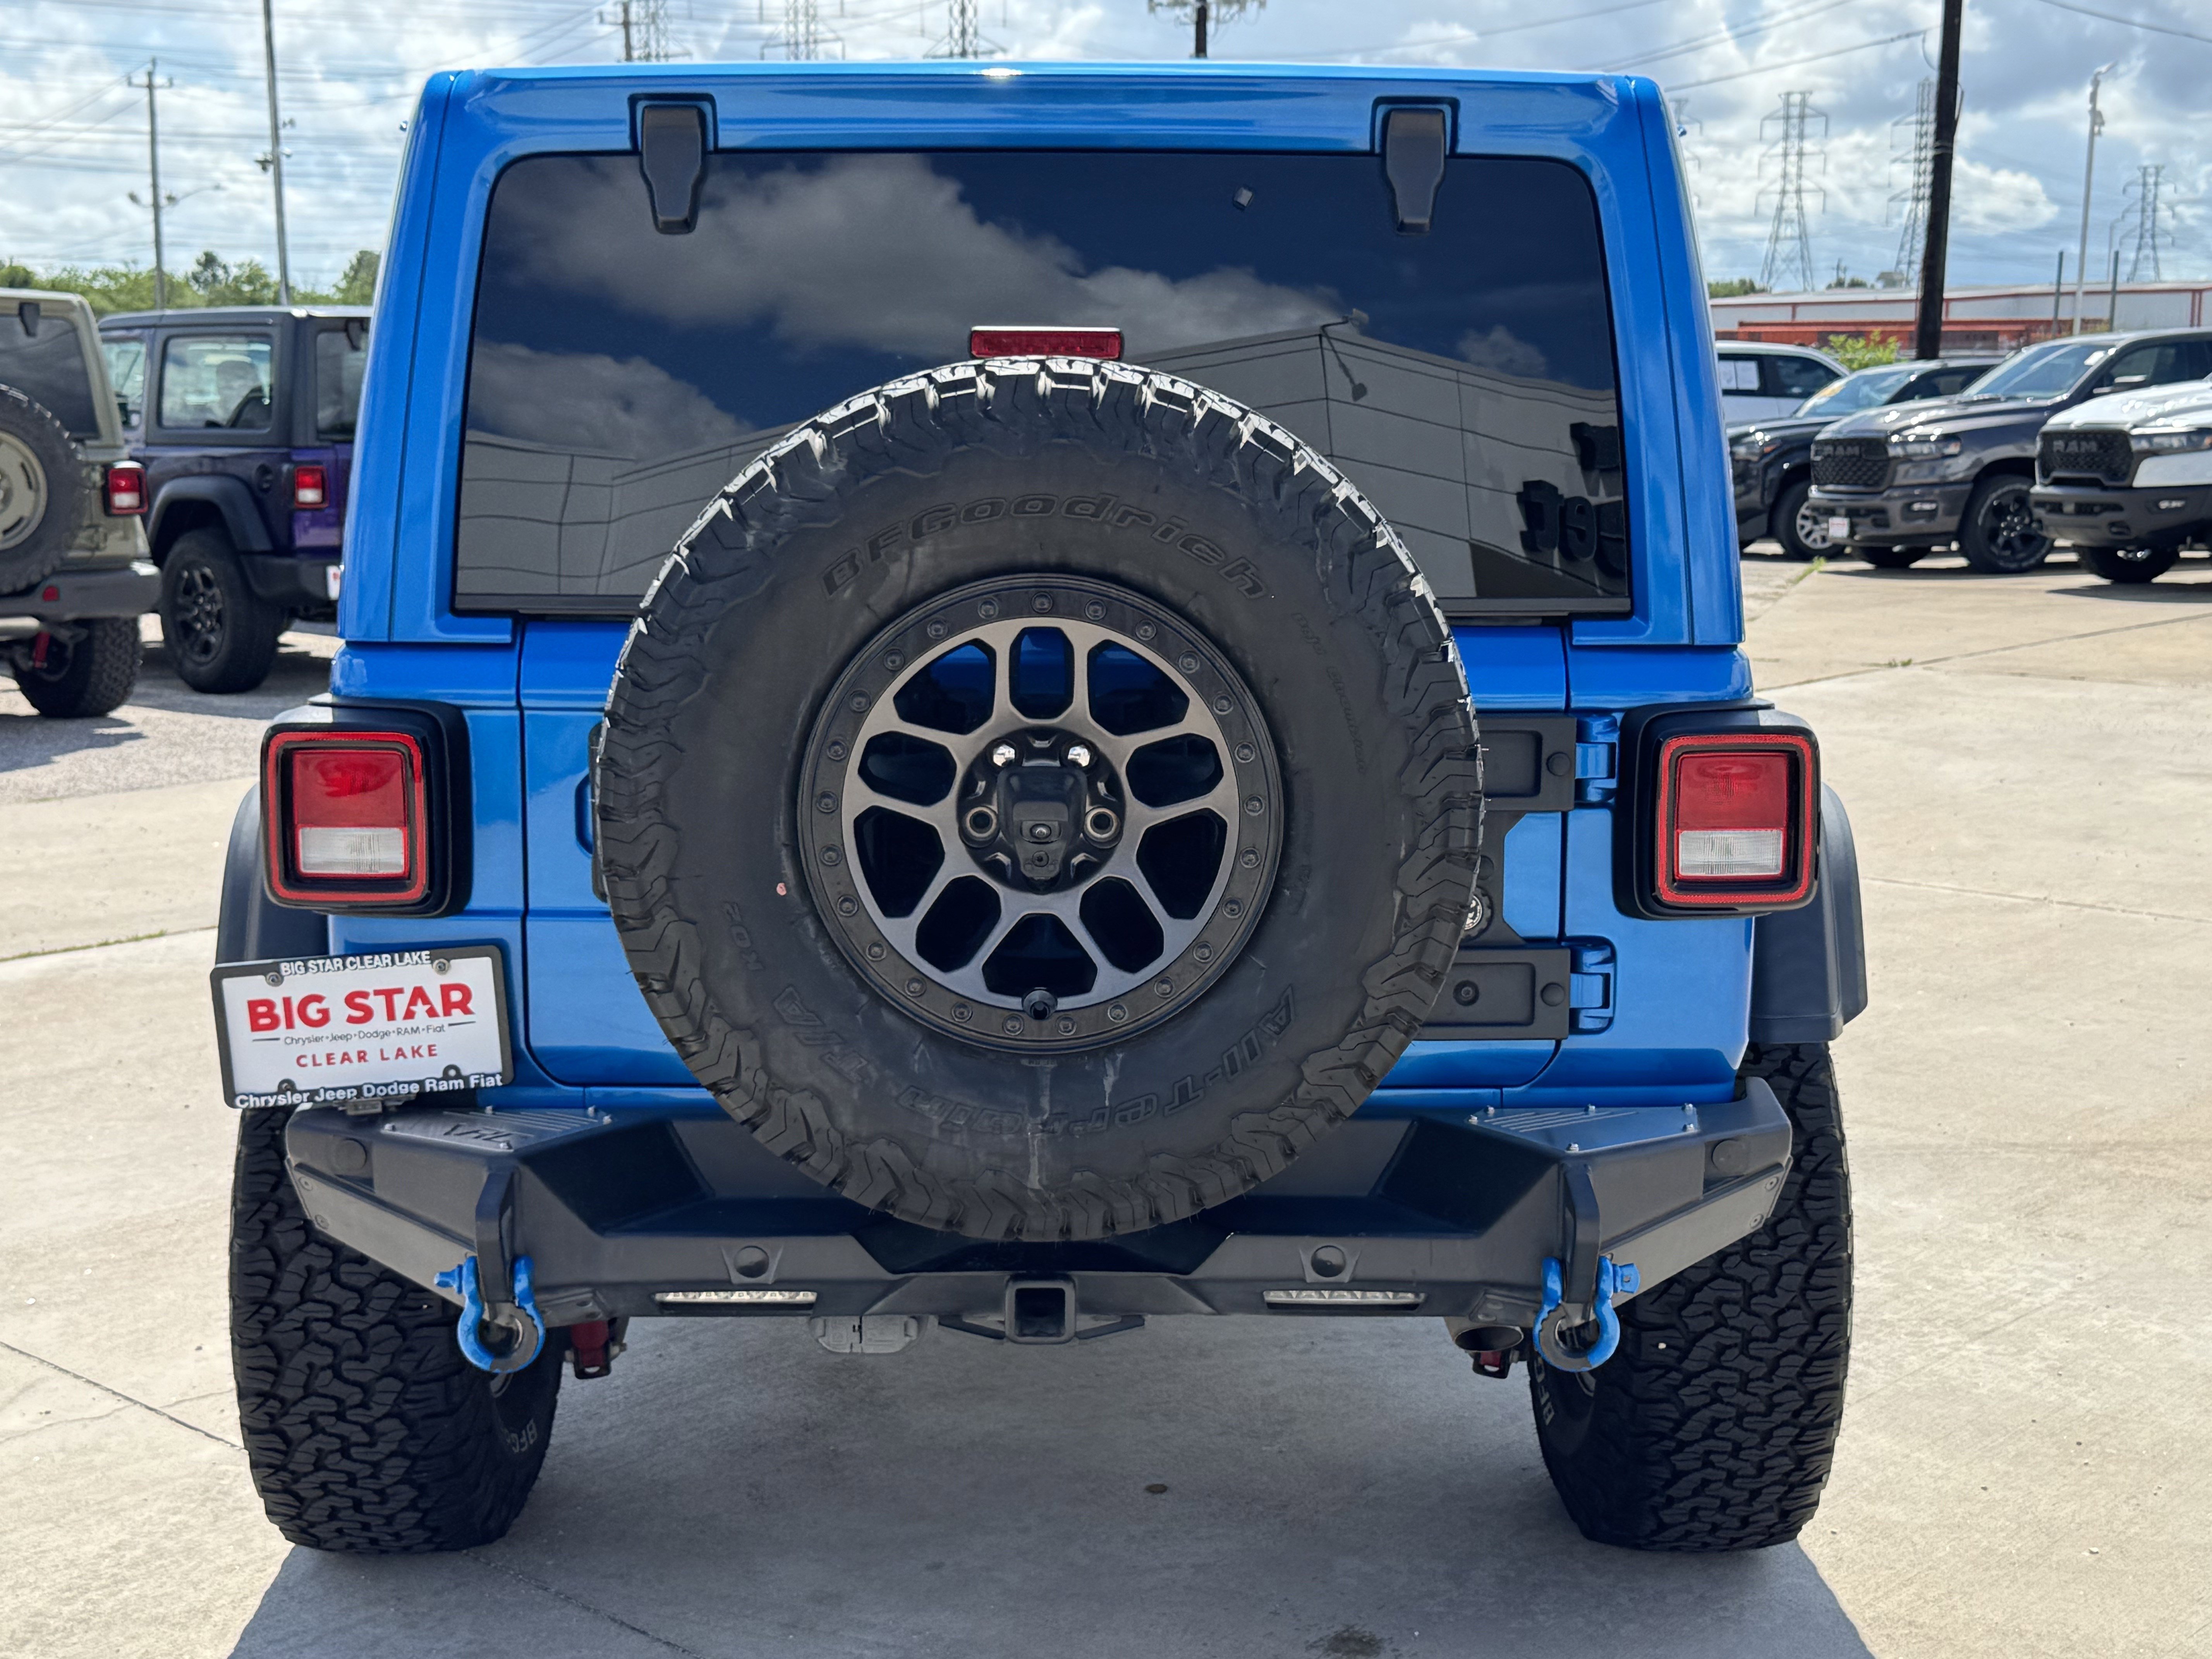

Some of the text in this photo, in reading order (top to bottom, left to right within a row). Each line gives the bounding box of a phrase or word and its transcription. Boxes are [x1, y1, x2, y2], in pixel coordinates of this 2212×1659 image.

[2052, 440, 2098, 452] RAM
[819, 493, 1272, 601] BFGoodrich
[280, 951, 431, 976] BIG STAR CLEAR LAKE
[247, 982, 476, 1032] BIG STAR
[296, 1044, 438, 1068] CLEAR LAKE
[235, 1073, 503, 1109] Chrysler Jeep Dodge Ram Fiat
